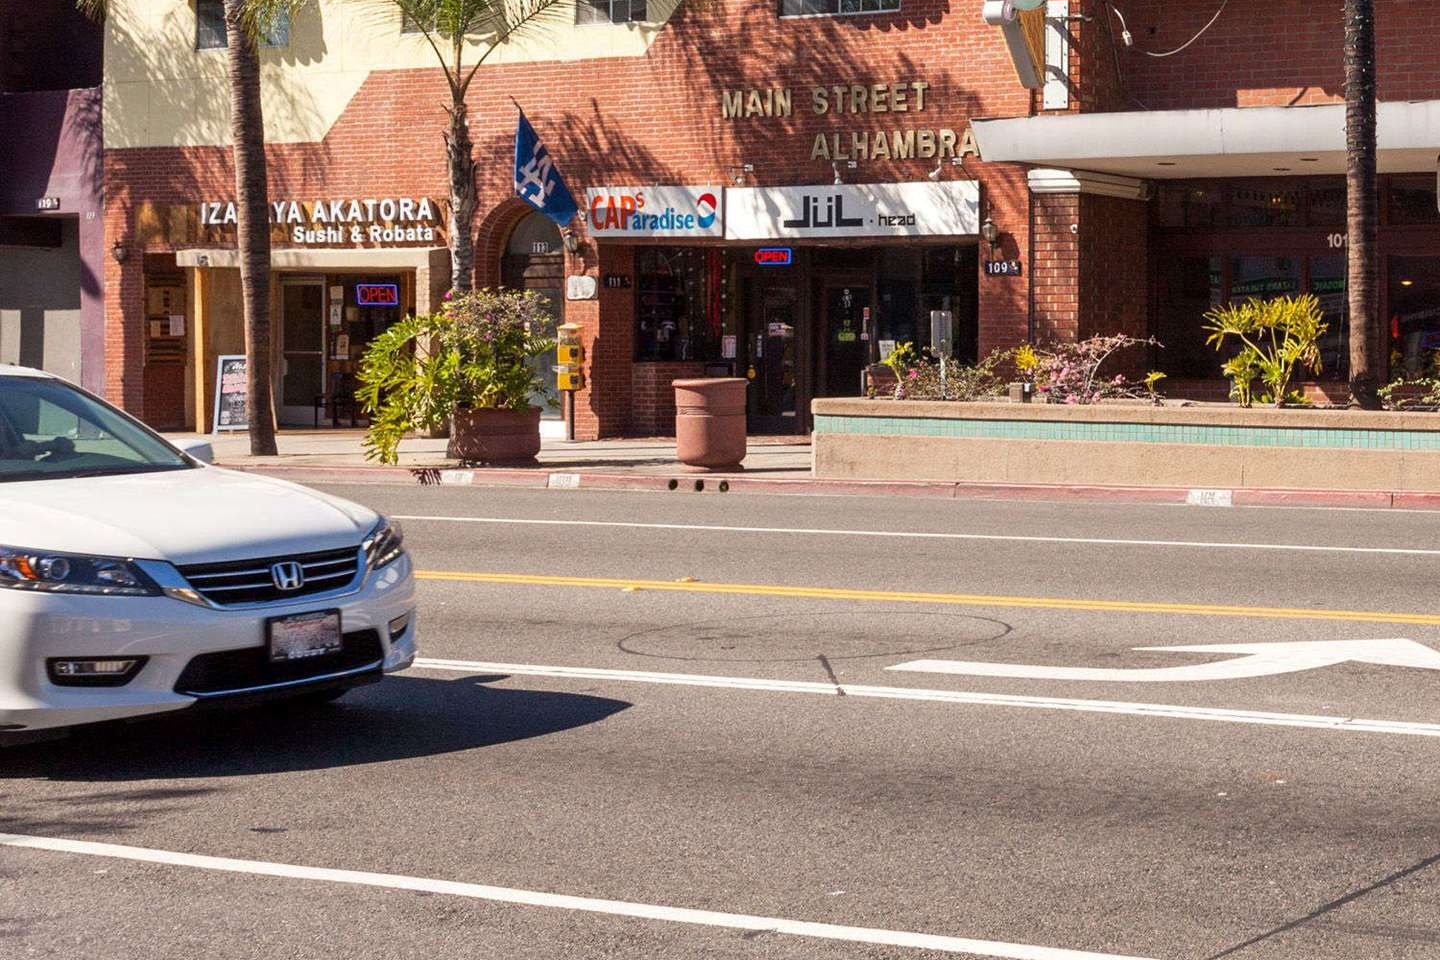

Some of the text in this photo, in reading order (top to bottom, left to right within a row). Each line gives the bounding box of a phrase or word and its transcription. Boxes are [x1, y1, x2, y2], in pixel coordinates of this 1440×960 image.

[722, 82, 929, 119] MAIN STREET
[810, 128, 980, 161] ALHAMBRA
[202, 197, 433, 225] IZAYA AKATORA
[878, 214, 916, 227] head
[293, 226, 433, 243] Sushi & Robata
[754, 251, 789, 263] OPEN
[989, 262, 1008, 274] 109
[360, 287, 397, 302] OPEN
